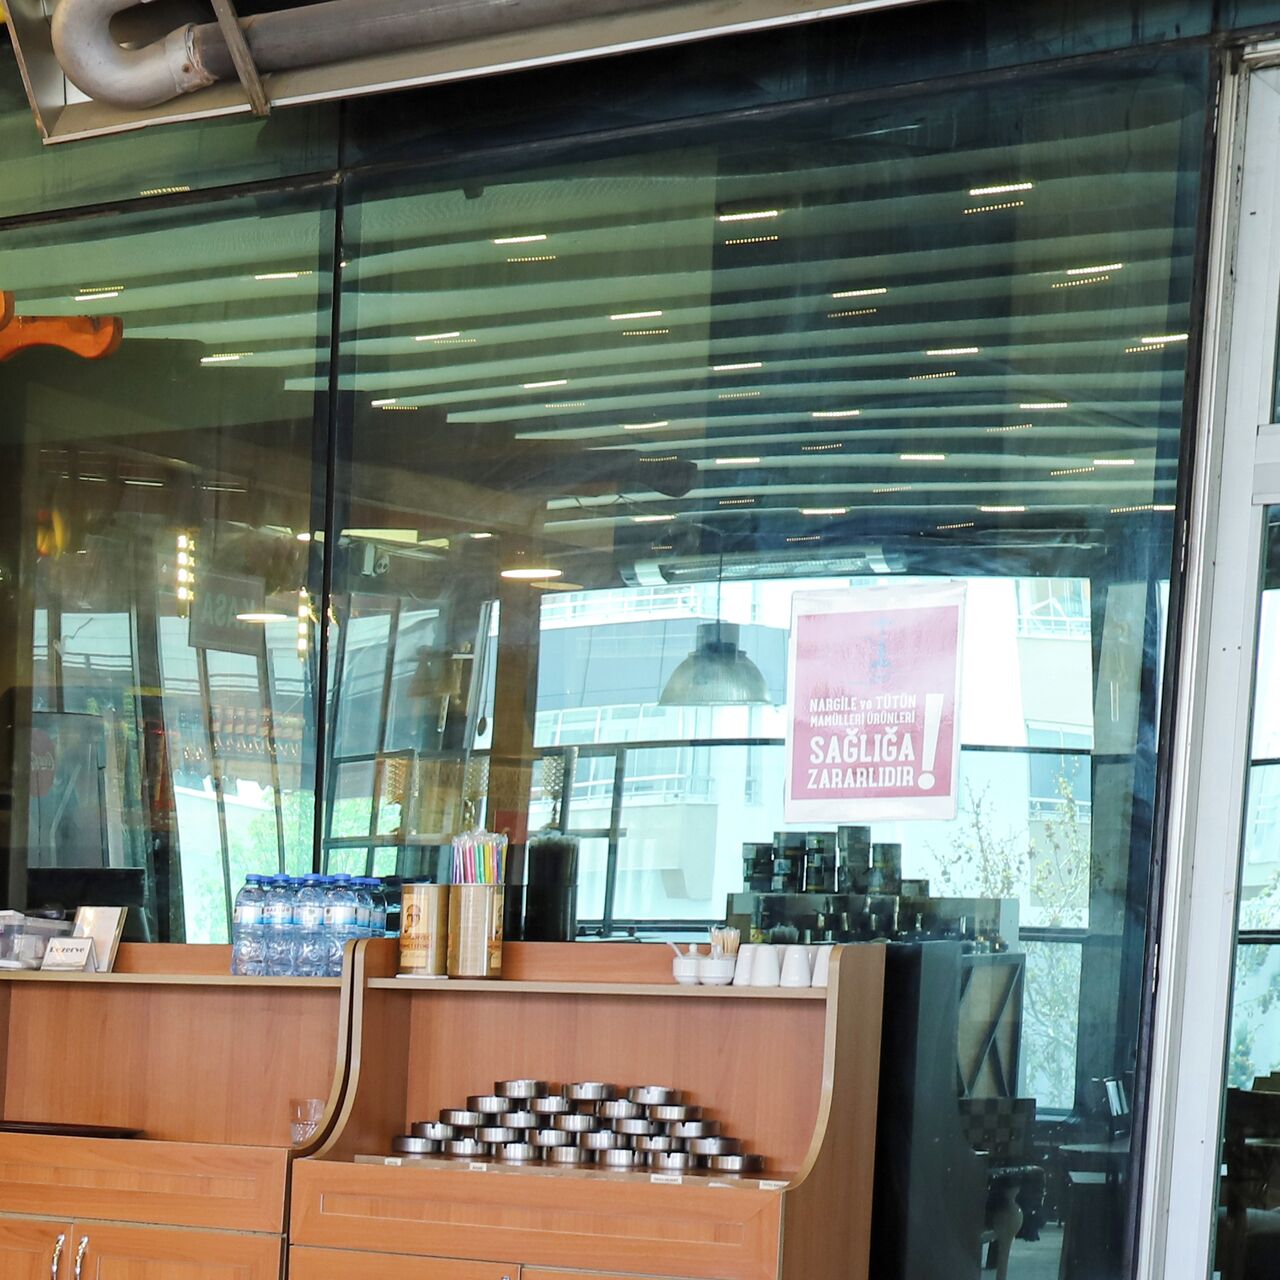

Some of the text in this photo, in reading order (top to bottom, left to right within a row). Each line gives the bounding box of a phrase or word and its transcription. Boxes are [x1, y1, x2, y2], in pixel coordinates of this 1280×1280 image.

[809, 696, 857, 712] NARGİLE
[876, 693, 916, 709] TÜTÜN
[810, 709, 916, 727] MAMÜLLERİ ÜRÜNLERİ
[809, 726, 915, 764] SAĞLIĞA
[807, 766, 914, 790] ZARARLIDIR
